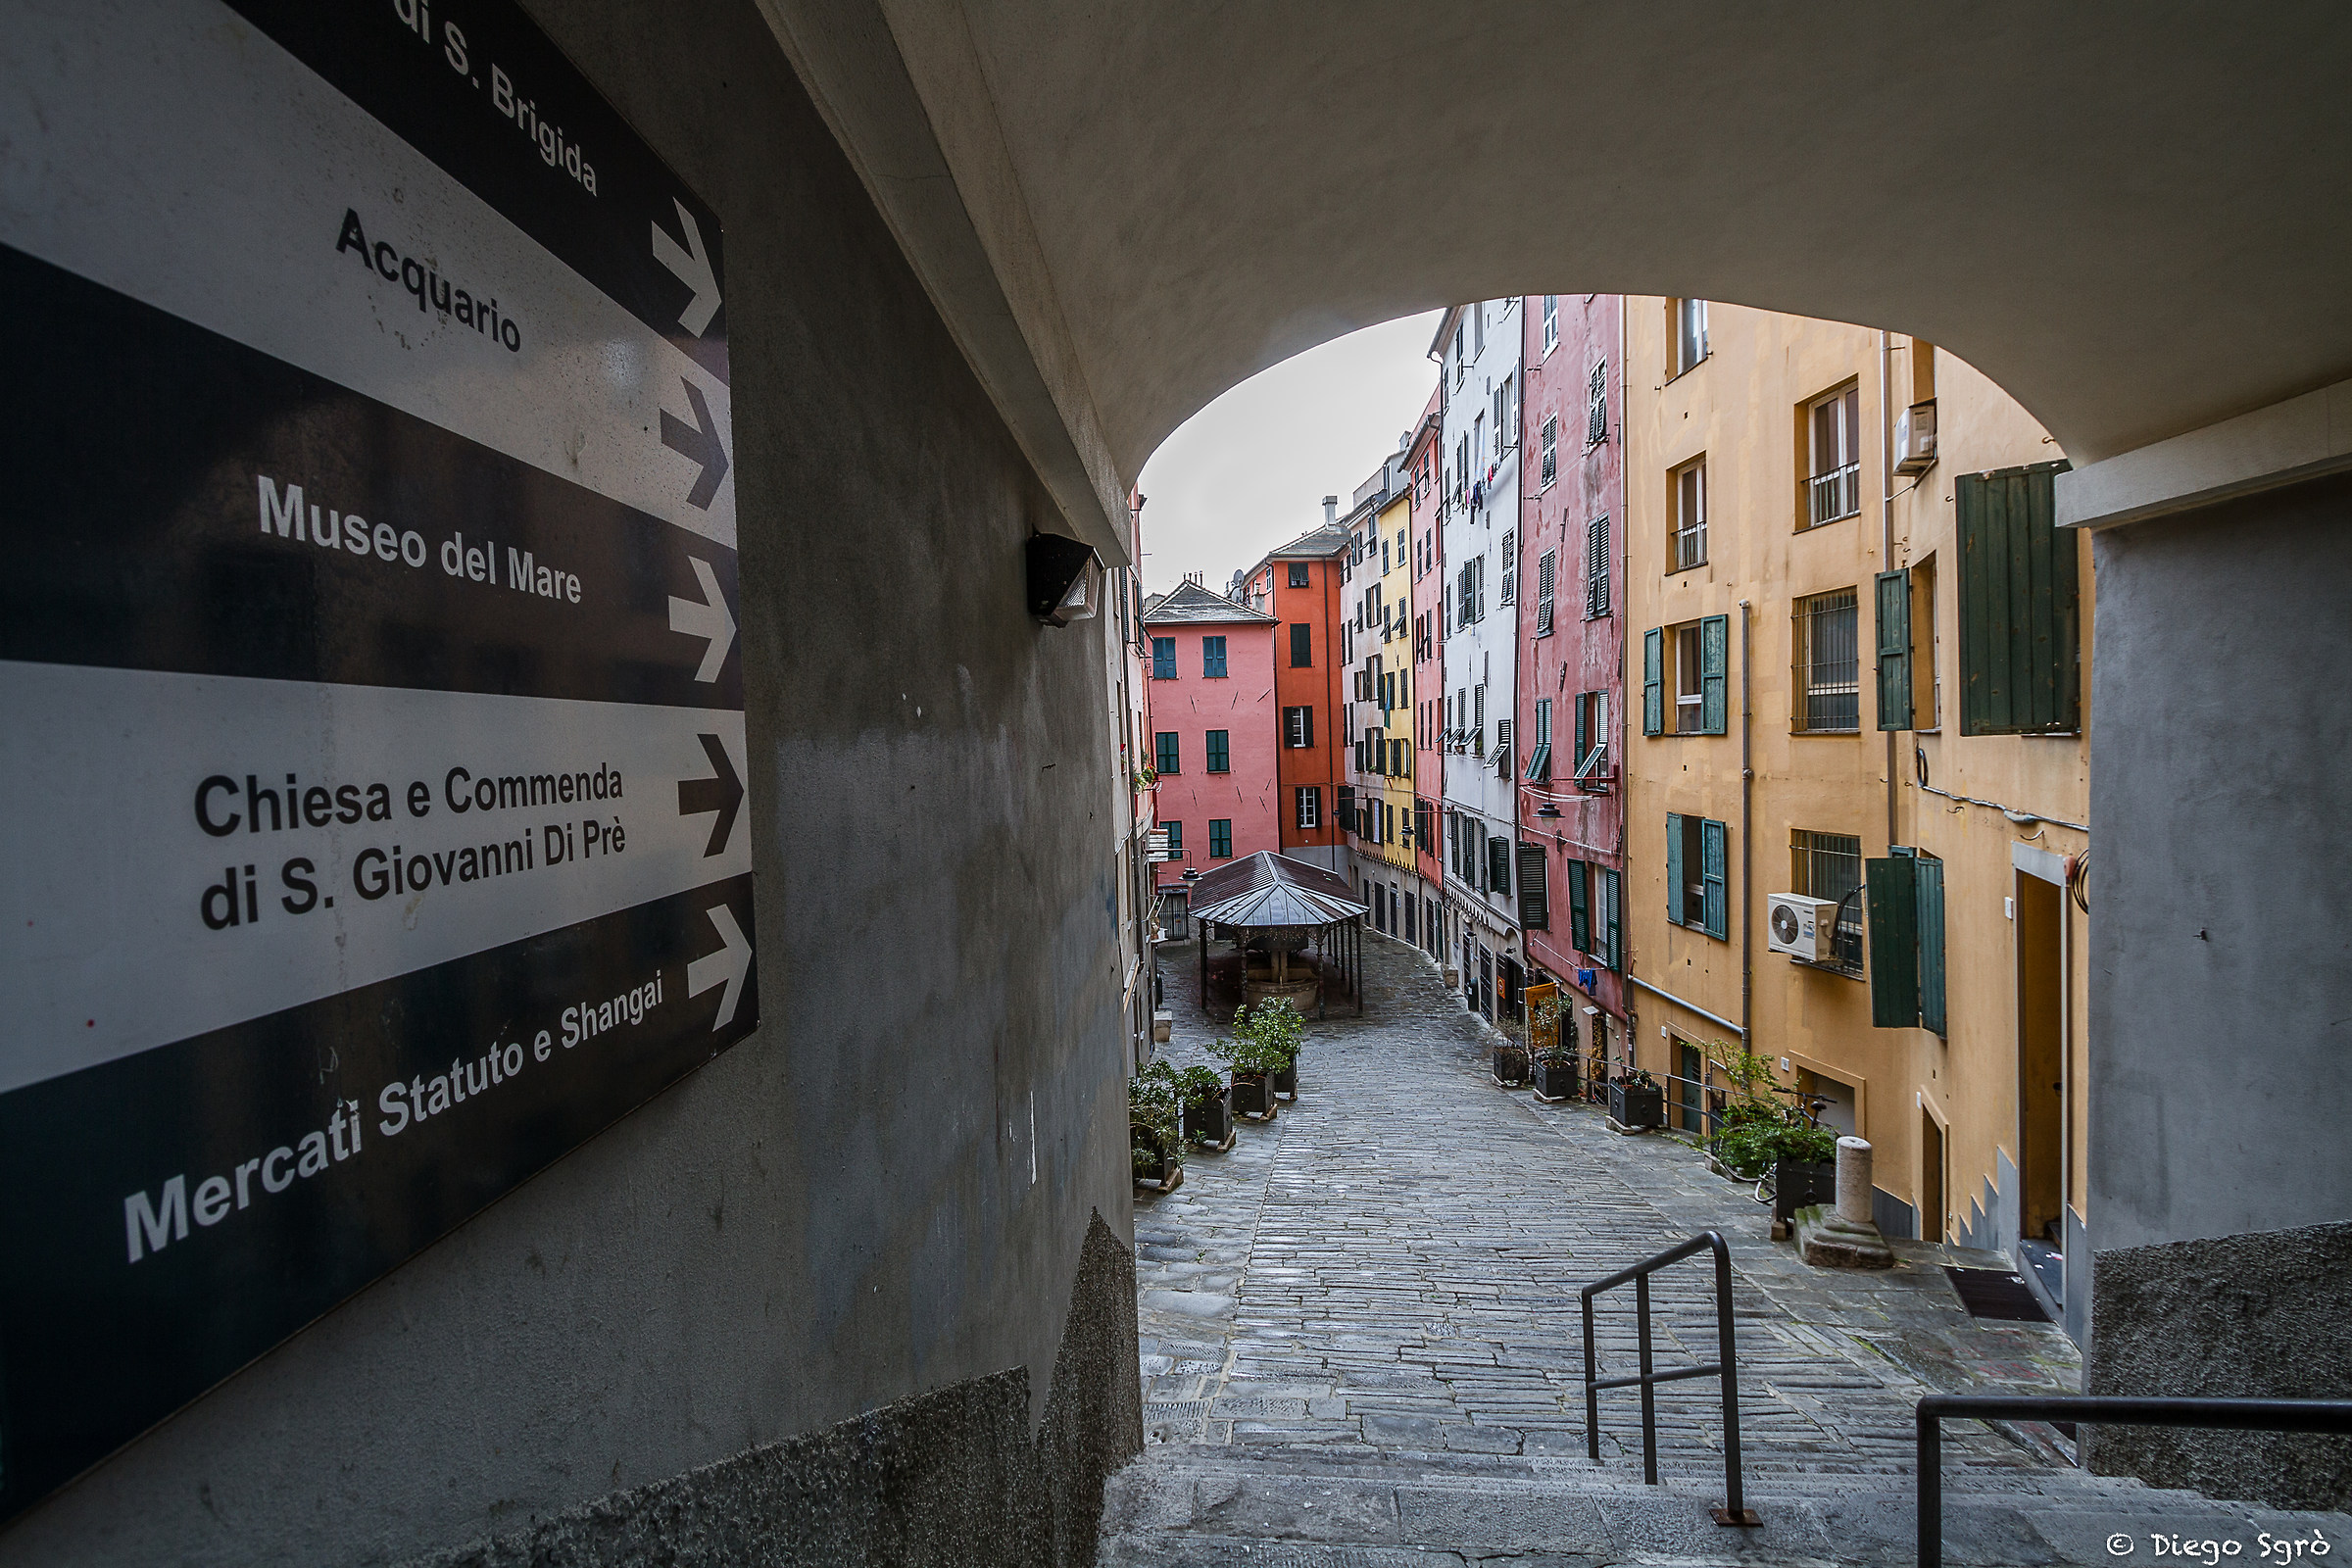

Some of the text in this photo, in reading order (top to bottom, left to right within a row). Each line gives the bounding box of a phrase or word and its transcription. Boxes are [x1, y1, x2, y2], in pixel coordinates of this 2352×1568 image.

[444, 21, 480, 89] S.
[492, 63, 598, 197] Brigida
[336, 207, 522, 354] Acquario
[258, 474, 582, 604] Museo del Mare
[194, 761, 624, 838] Chiesa e Commenda
[200, 815, 626, 931] di S. Giovanni Di Prè
[123, 969, 664, 1264] Mercati Statuto e Shangai
